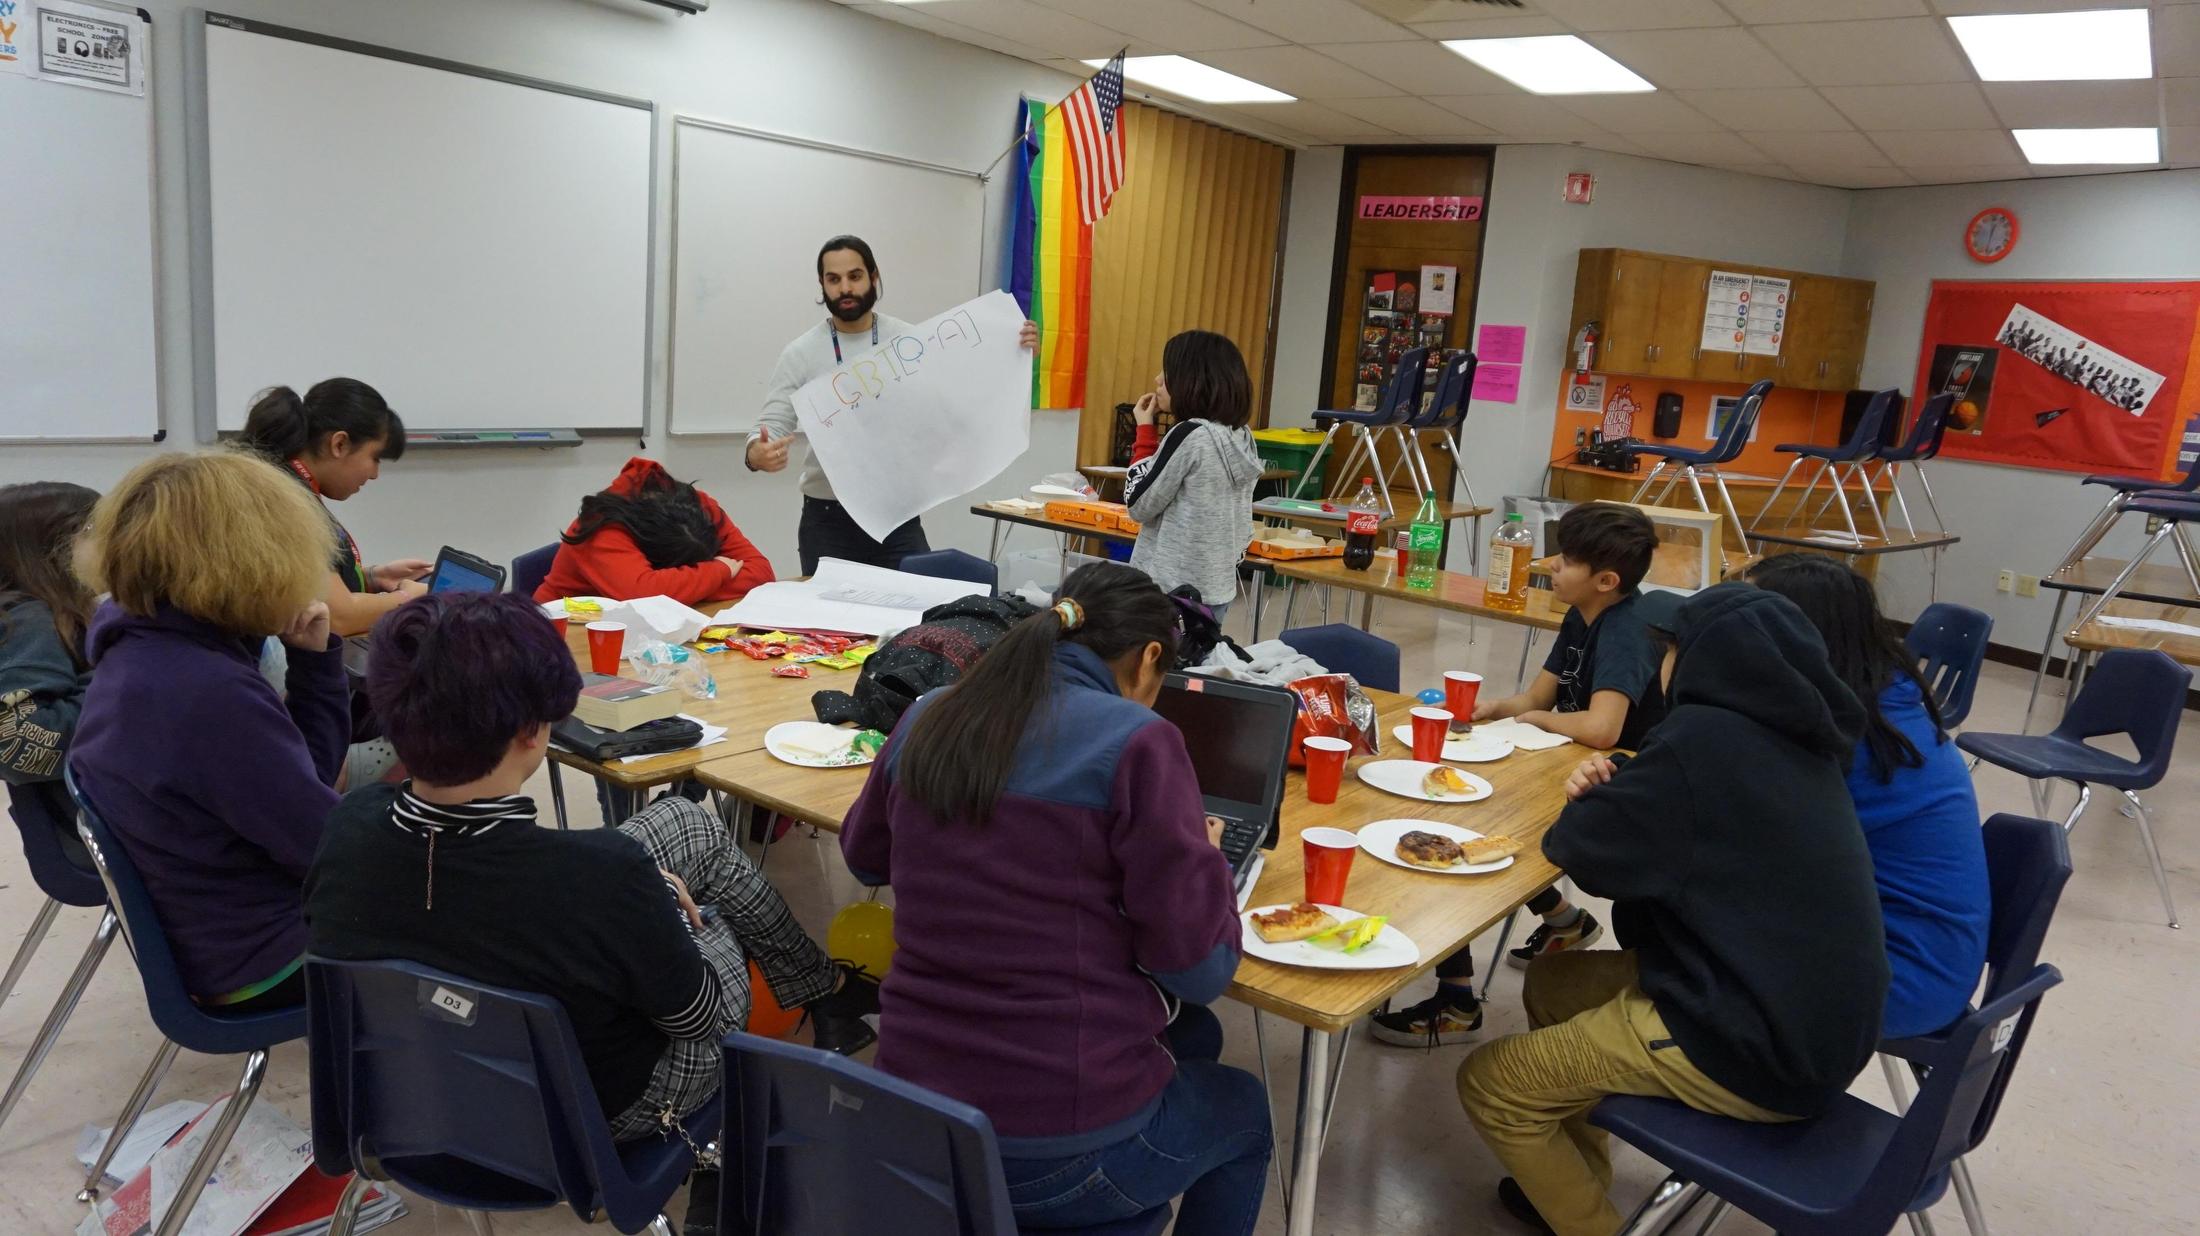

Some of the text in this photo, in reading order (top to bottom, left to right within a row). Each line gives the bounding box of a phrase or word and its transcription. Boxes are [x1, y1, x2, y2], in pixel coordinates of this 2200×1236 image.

[47, 16, 95, 31] ELECTRONICS
[57, 27, 86, 37] SCHOOL
[1363, 203, 1478, 219] LEADERSHIP
[443, 996, 461, 1010] D3
